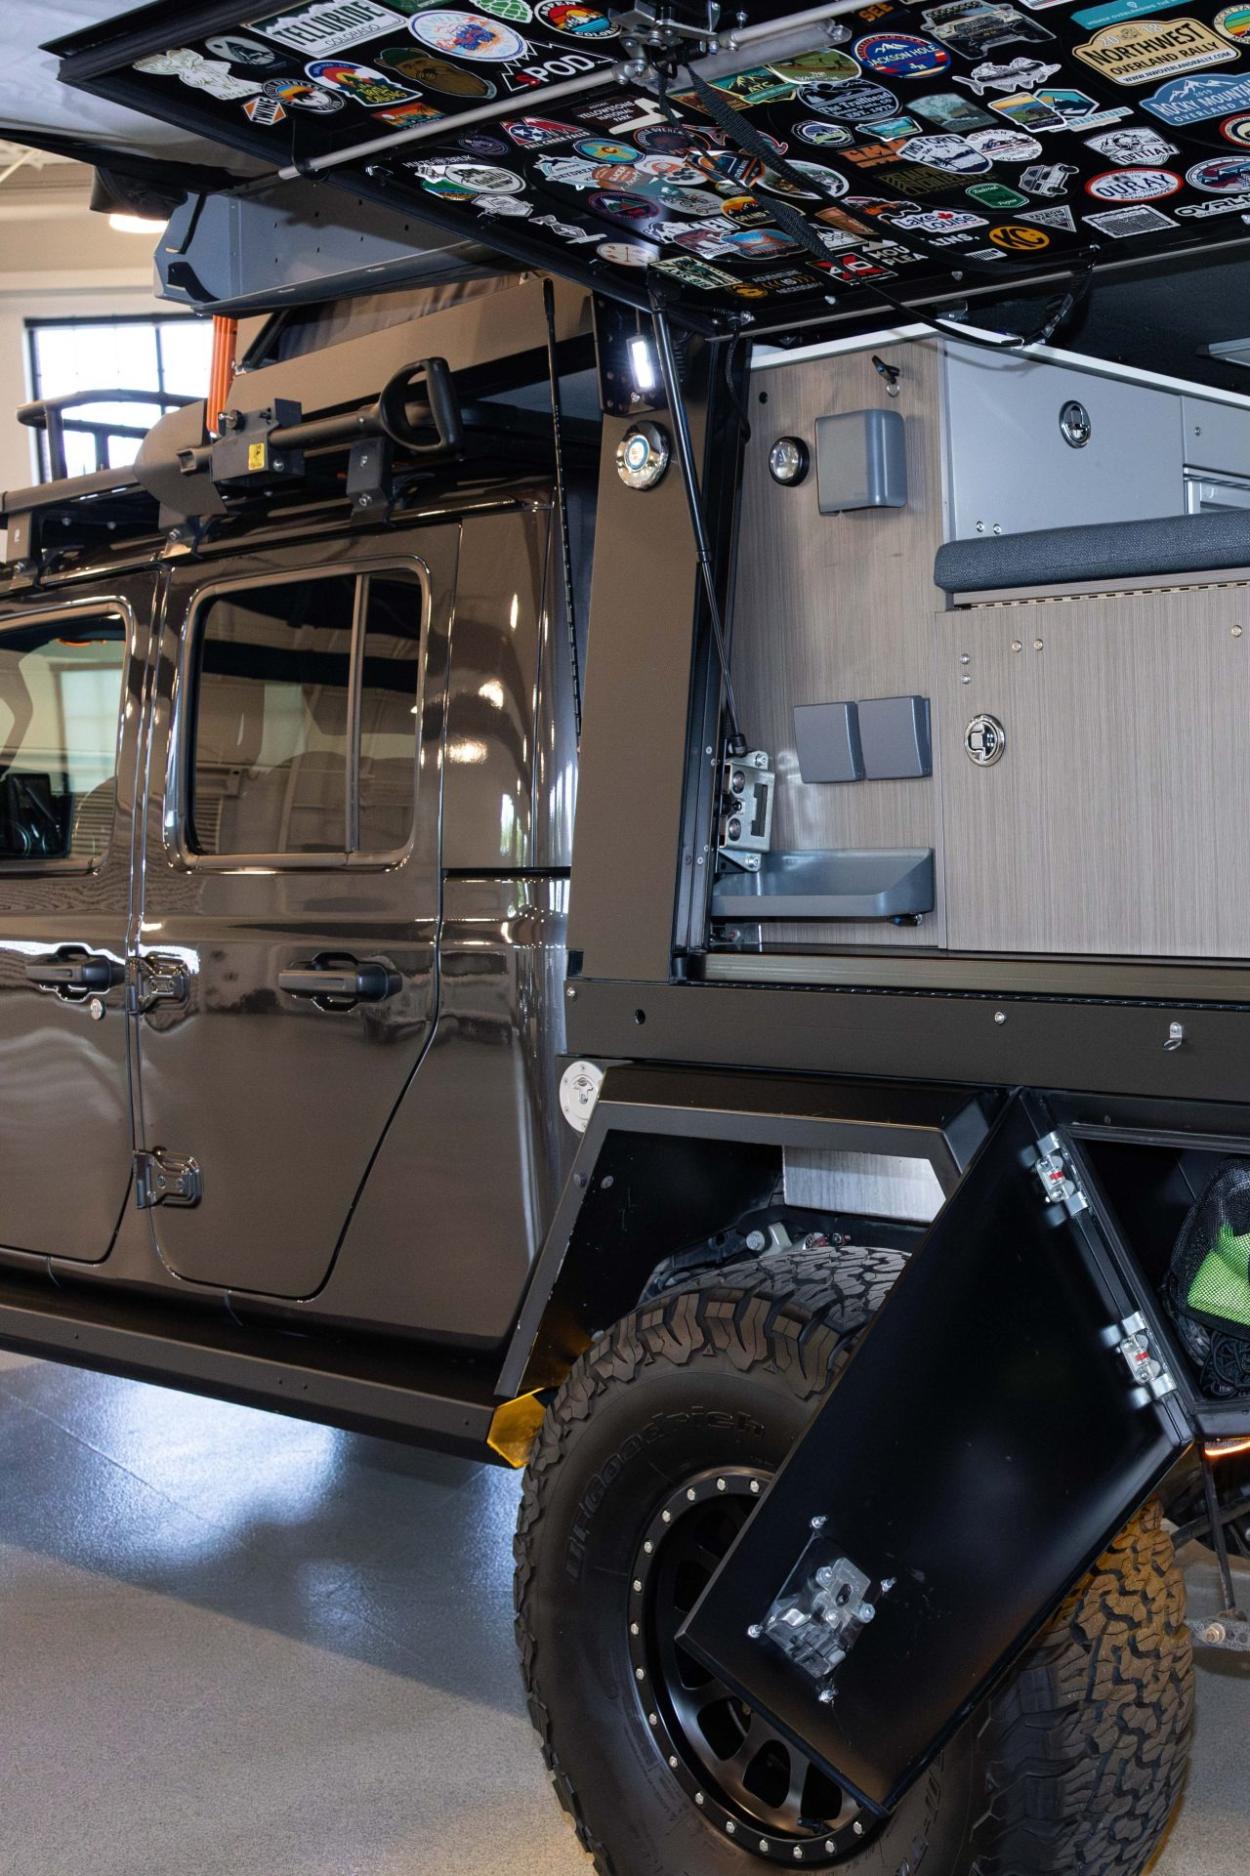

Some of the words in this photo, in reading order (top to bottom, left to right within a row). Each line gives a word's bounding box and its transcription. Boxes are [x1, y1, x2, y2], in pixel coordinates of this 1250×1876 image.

[540, 1, 577, 16] ASPEN
[272, 1, 387, 46] TELLURIDE
[325, 24, 381, 46] COLORADO
[1083, 23, 1205, 66] NORTHWEST
[868, 50, 912, 67] JACKSON
[913, 43, 939, 57] HOLE
[1110, 52, 1179, 75] OVERLAND
[1181, 41, 1219, 58] RALLY
[1153, 99, 1199, 117] ROCKY
[1174, 100, 1236, 122] OVERLAND
[1096, 173, 1171, 198] OURAY
[900, 214, 937, 228] Lake
[928, 213, 978, 231] Louise
[996, 226, 1044, 249] KC
